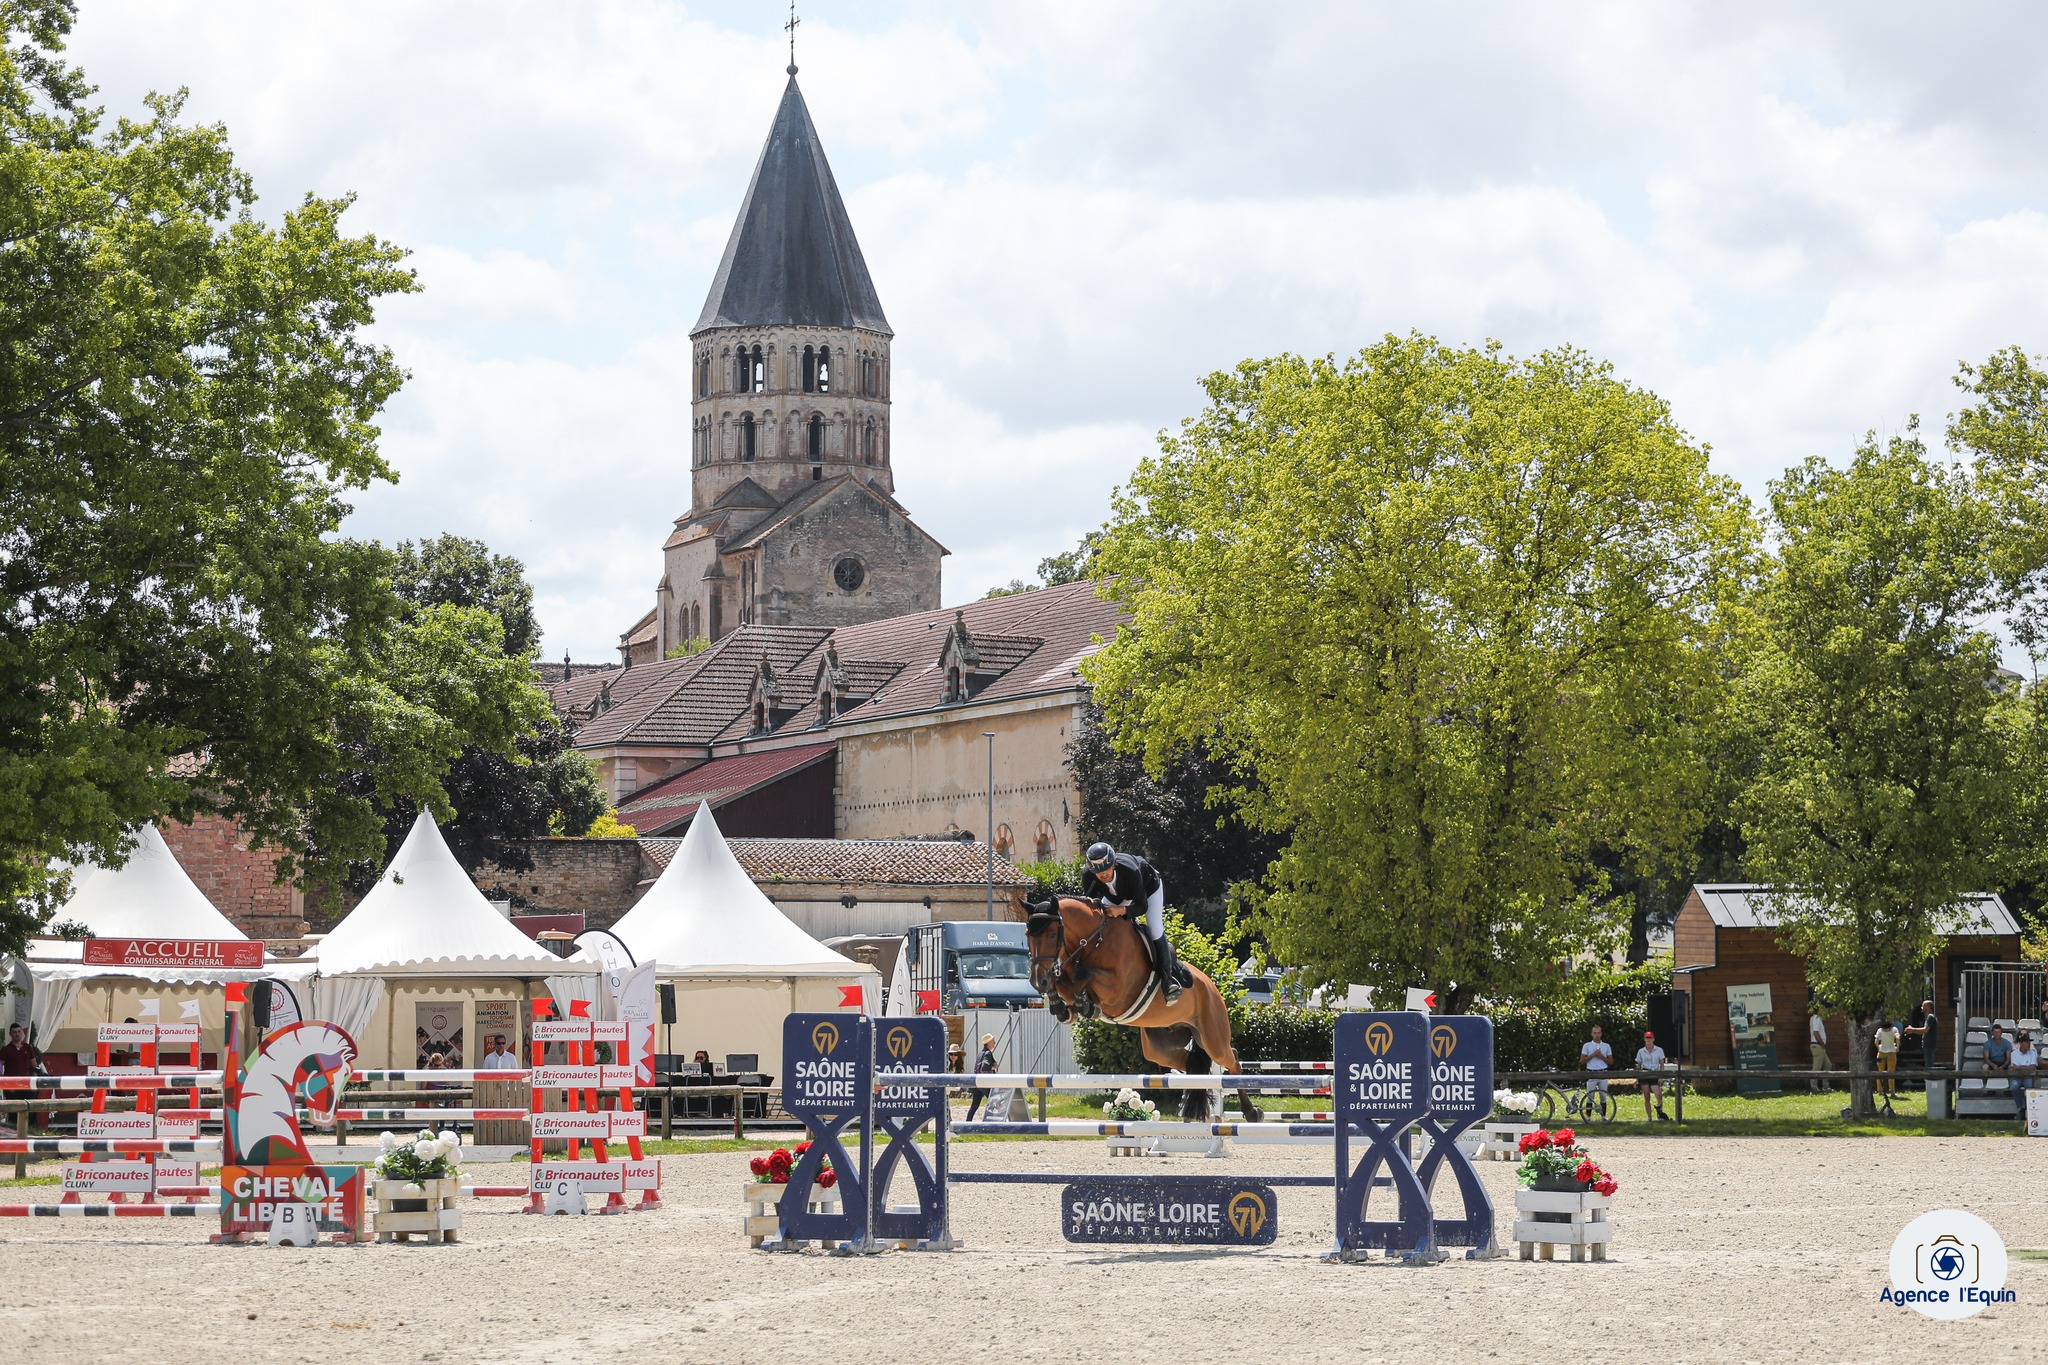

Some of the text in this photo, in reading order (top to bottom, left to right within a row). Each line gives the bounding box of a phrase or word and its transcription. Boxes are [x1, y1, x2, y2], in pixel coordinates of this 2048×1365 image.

[125, 942, 224, 957] ACCUEIL
[124, 956, 224, 966] COMMISSARIAT GENERAL
[542, 1071, 598, 1079] Briconautes
[795, 1057, 855, 1078] SAÔNE
[1349, 1059, 1412, 1080] SAÔNE
[1430, 1061, 1475, 1082] AÔNE
[806, 1081, 855, 1097] LOIRE
[1350, 1083, 1412, 1100] & LOIRE
[1432, 1084, 1475, 1101] OIRE
[89, 1118, 150, 1128] Briconautes
[543, 1118, 606, 1128] Briconautes
[75, 1169, 149, 1180] Briconautes
[545, 1169, 619, 1180] Briconautes
[234, 1176, 344, 1198] CHEVAL
[558, 1182, 568, 1196] C
[234, 1198, 344, 1222] LIBTÉ
[283, 1208, 294, 1223] B
[1072, 1197, 1145, 1222] SAÔNE
[1148, 1207, 1156, 1217] &
[1160, 1203, 1220, 1223] LOIRE
[1072, 1224, 1220, 1236] DÉPARTEMENT
